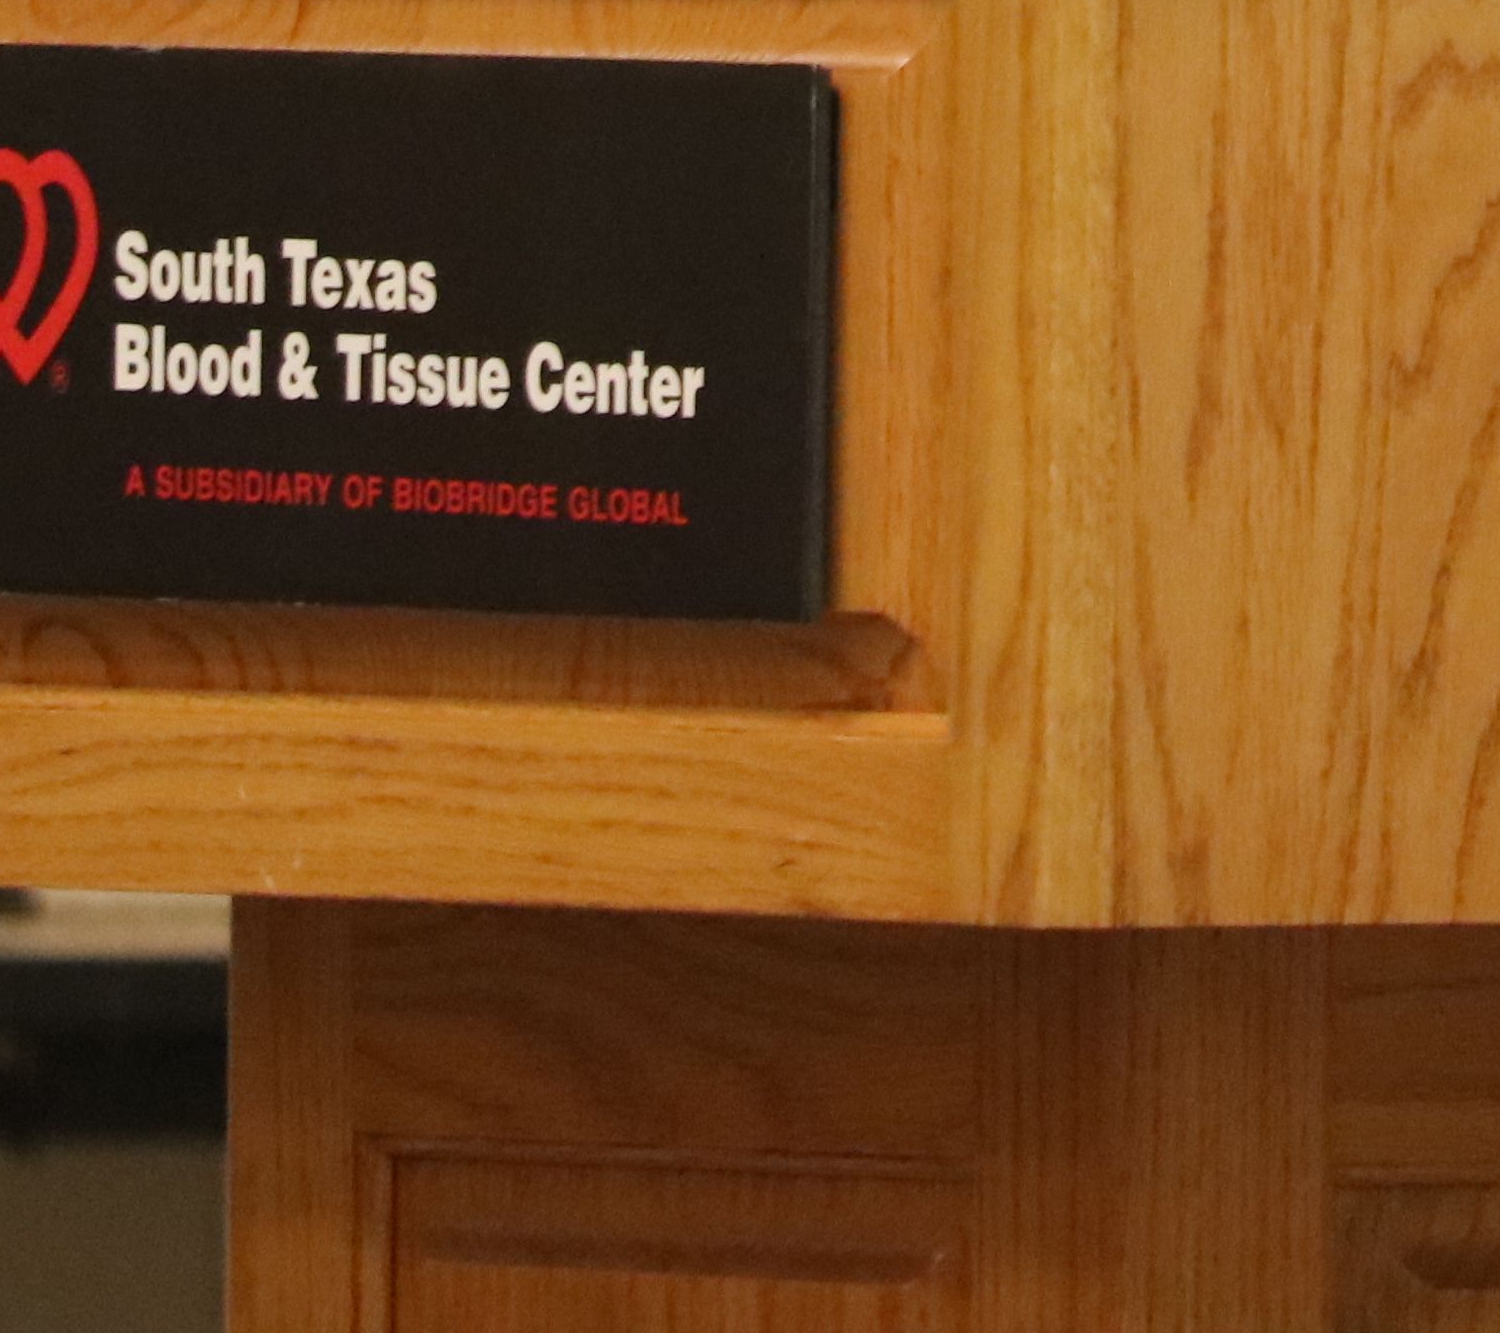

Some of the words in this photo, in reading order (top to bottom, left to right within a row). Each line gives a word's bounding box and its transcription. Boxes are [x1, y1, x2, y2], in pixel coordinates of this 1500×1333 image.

[114, 230, 266, 305] South
[281, 238, 437, 314] Texas
[113, 323, 262, 398] Blood
[277, 331, 319, 401] &
[335, 333, 511, 410] Tissue
[524, 341, 705, 419] Center
[123, 464, 148, 497] A
[153, 464, 334, 507] SUBSIDIARY
[340, 472, 388, 510] OF
[390, 475, 560, 520] BIOBRIDGE
[566, 484, 690, 527] GLOBAL
